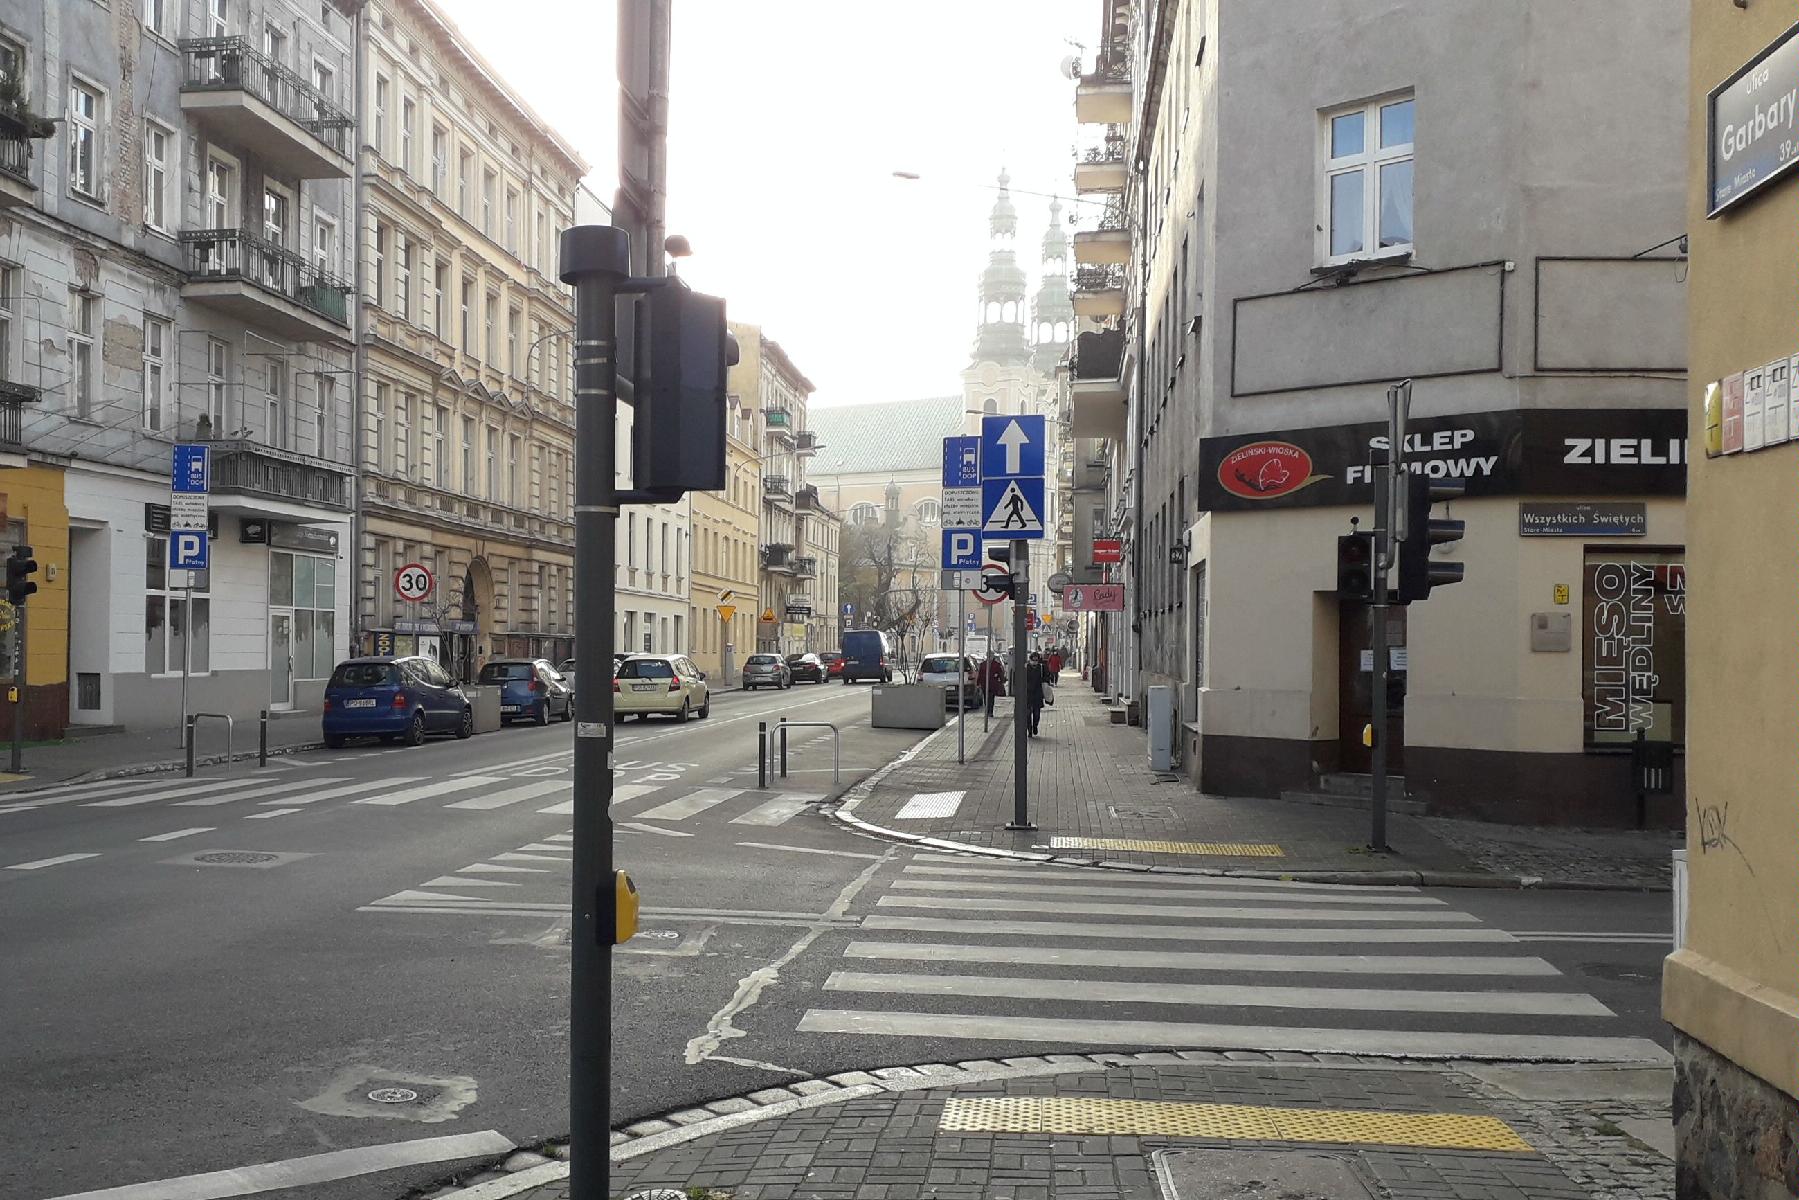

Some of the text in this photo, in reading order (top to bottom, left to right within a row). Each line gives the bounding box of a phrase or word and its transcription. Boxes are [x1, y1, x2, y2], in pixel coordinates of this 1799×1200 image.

[1746, 68, 1769, 95] ulica
[1721, 88, 1797, 161] Garbary
[1779, 140, 1792, 161] 39
[1563, 438, 1688, 465] ZIELI
[1346, 456, 1499, 485] FIMOWY
[1523, 511, 1645, 528] Wszystkich Świętych
[401, 573, 427, 592] 30
[1594, 562, 1631, 731] MIĘSO
[1629, 560, 1659, 734] WĘDLINY
